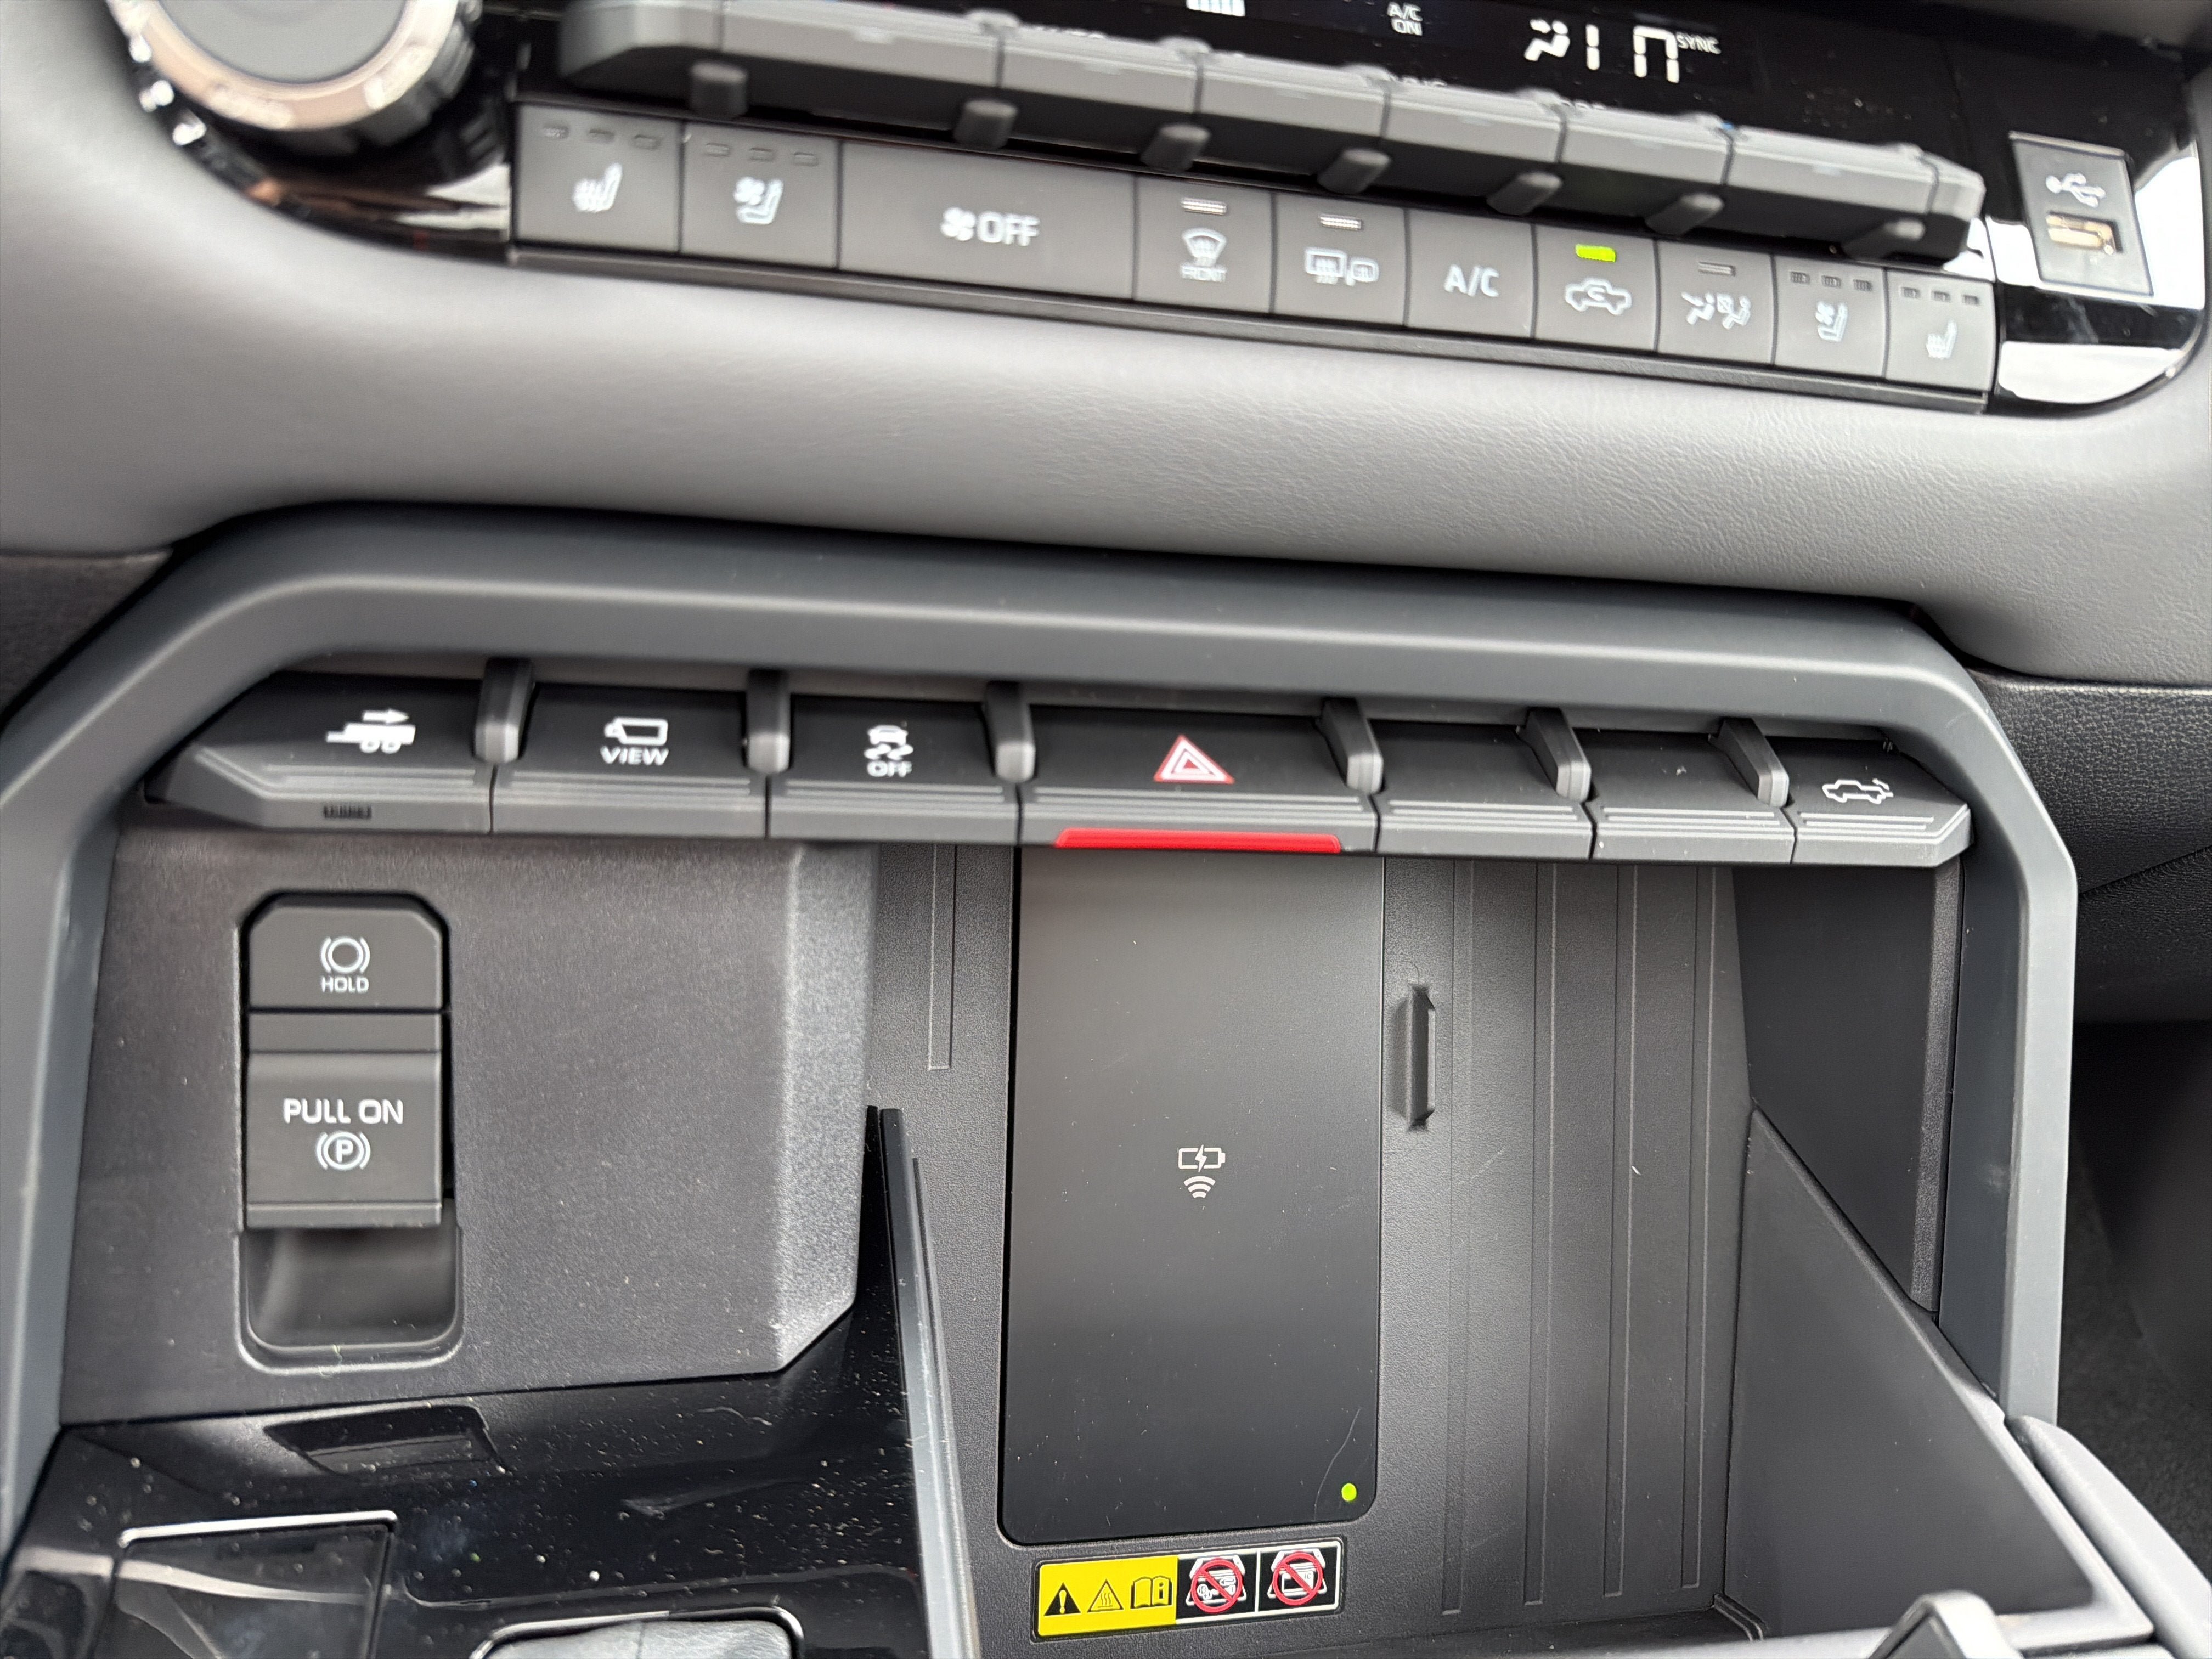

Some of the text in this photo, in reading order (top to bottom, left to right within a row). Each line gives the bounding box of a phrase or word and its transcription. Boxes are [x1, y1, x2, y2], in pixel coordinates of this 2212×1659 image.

[1387, 2, 1423, 21] A/C
[1392, 18, 1423, 36] ON
[1675, 32, 1721, 54] SYNC
[977, 211, 1040, 246] OFF
[1181, 264, 1227, 282] FRONT
[1444, 264, 1500, 297] A/C
[600, 746, 669, 765] VIEW
[866, 760, 912, 777] OFF
[321, 977, 369, 993] HOLD
[283, 1098, 403, 1124] PULL ON
